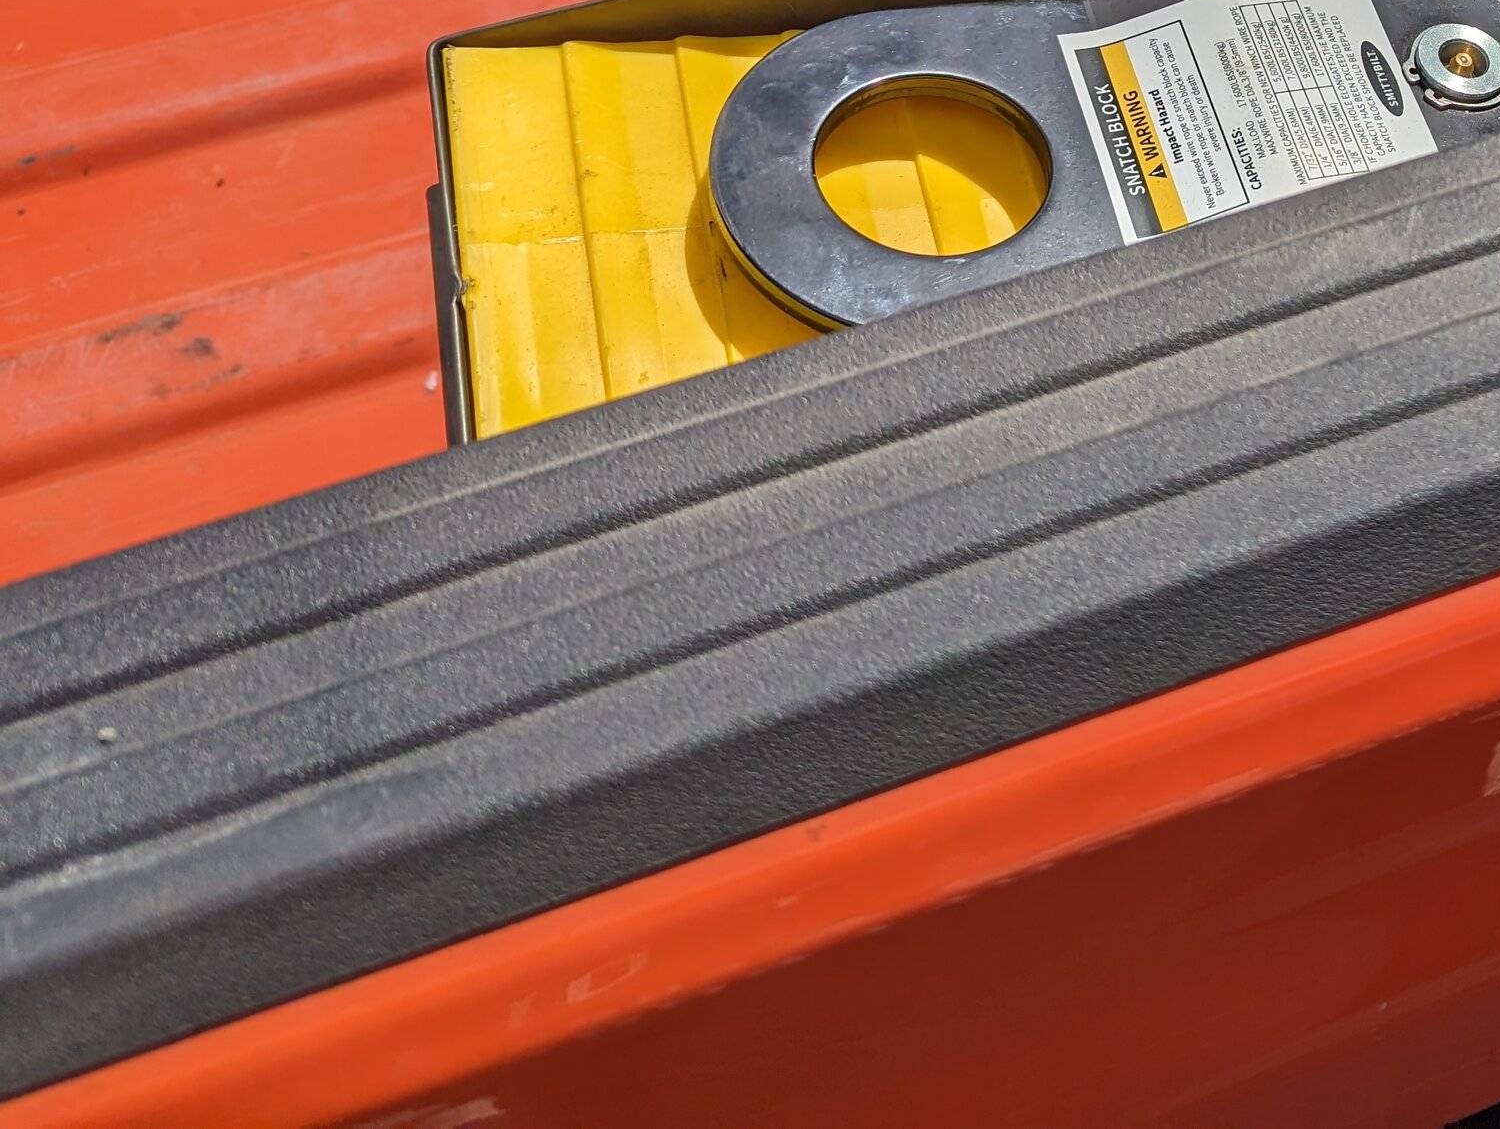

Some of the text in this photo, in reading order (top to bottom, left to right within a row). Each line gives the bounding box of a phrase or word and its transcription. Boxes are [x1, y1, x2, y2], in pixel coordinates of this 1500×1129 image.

[1303, 6, 1324, 40] MAXIMUM
[1162, 41, 1224, 196] Broken wire rope or snatch block can cause
[1185, 73, 1221, 152] severe injury or death
[1228, 5, 1307, 185] MAXIMUM CAPACITIES FOR NEW WINCH WIRE ROPE
[1248, 96, 1263, 118] ROPE
[1316, 11, 1385, 156] CAPACITY HAS BEEN EXCEEDED AND THE
[1330, 15, 1396, 152] SNATCH BLOCK SHOULD BE REPLACED
[1343, 100, 1359, 121] HOLE
[1093, 83, 1145, 195] SNATCH BLOCK
[1122, 90, 1159, 161] WARNING
[1147, 88, 1184, 164] Impact Hazard
[1148, 38, 1216, 209] Never exceed wire rope or snatch block capacity
[1231, 127, 1262, 189] CAPACITIES:
[1353, 122, 1373, 154] CHOKER
